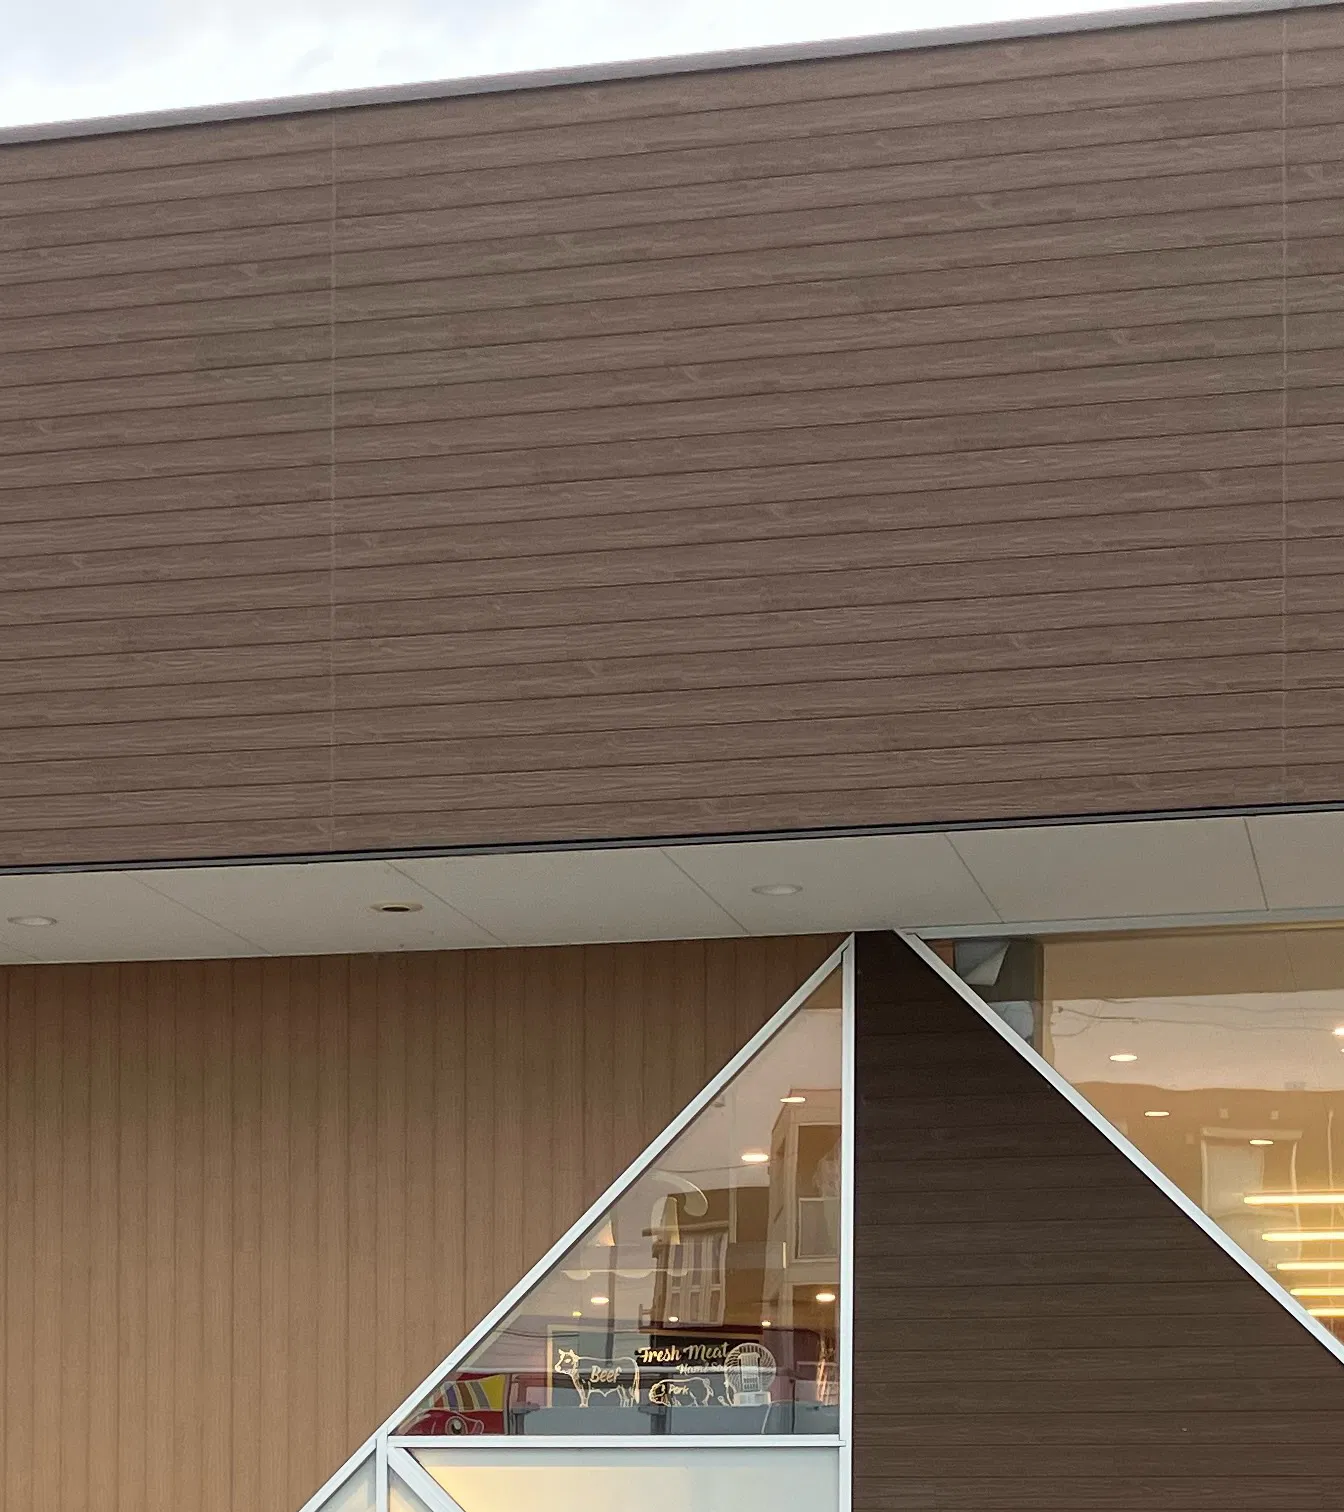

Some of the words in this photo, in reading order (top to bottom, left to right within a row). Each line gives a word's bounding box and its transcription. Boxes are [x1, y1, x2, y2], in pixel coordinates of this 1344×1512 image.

[638, 1345, 682, 1363] Fresh
[683, 1341, 730, 1361] Meat
[589, 1365, 622, 1384] Beef
[668, 1382, 690, 1395] Pork
